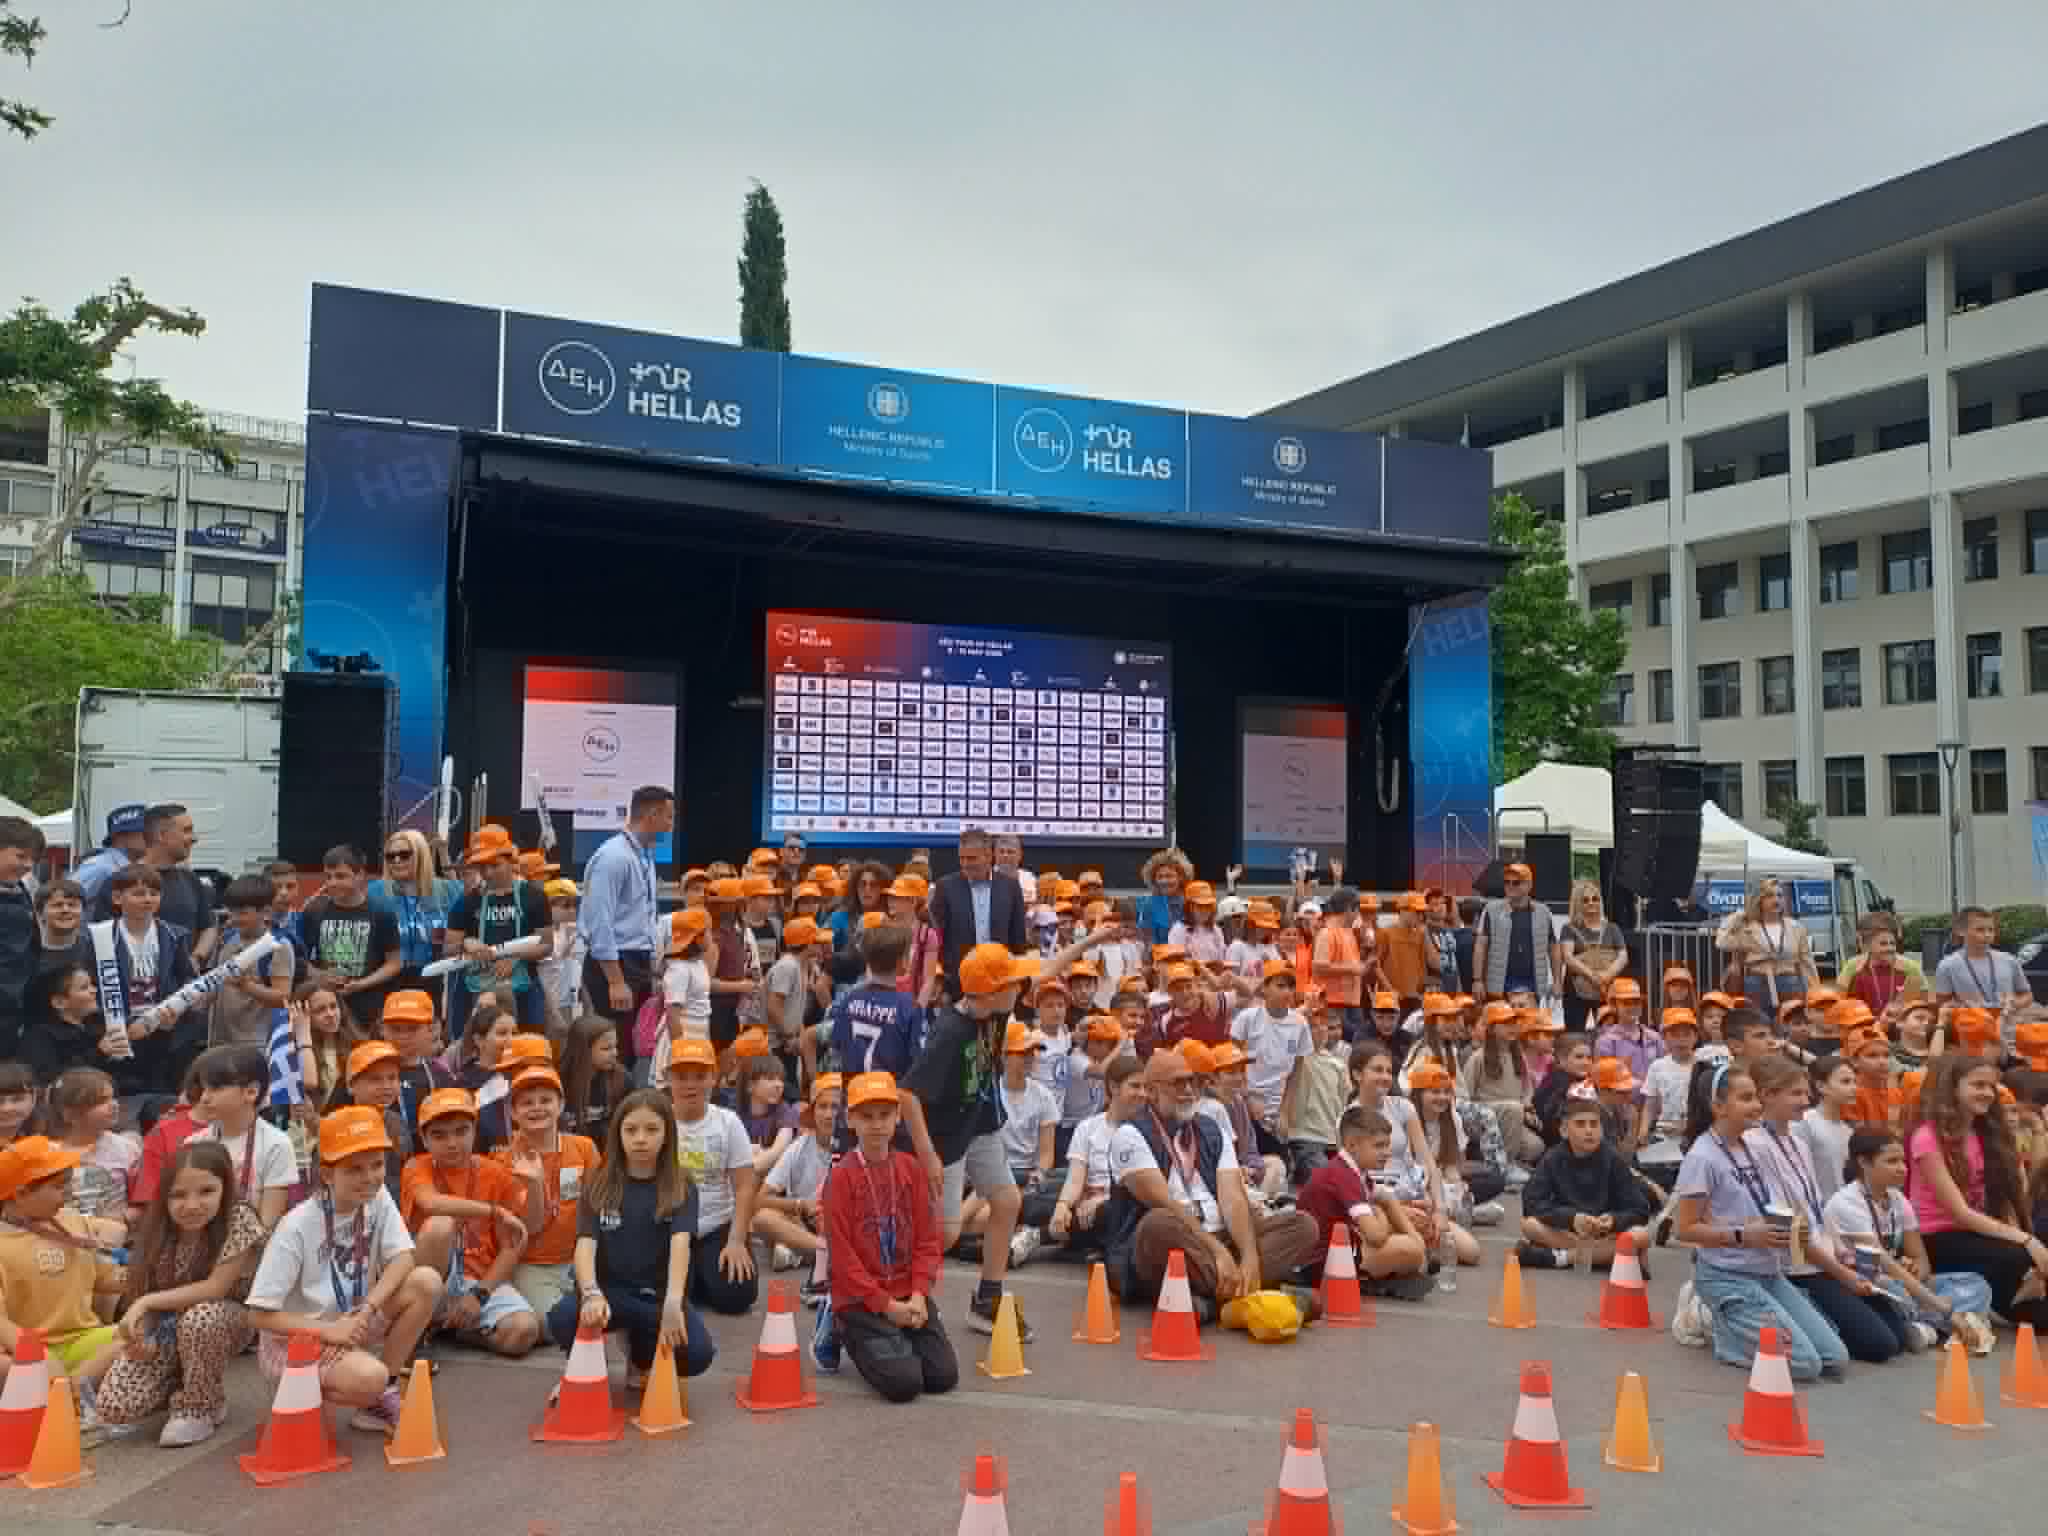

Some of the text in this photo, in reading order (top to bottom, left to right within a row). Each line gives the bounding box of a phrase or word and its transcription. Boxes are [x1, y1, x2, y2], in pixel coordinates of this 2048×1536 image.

[547, 359, 605, 396] ΔΕΗ
[628, 390, 742, 428] HELLAS
[1021, 423, 1066, 457] ΔΕΗ
[1083, 449, 1172, 480] HELLAS
[851, 1021, 882, 1073] 7
